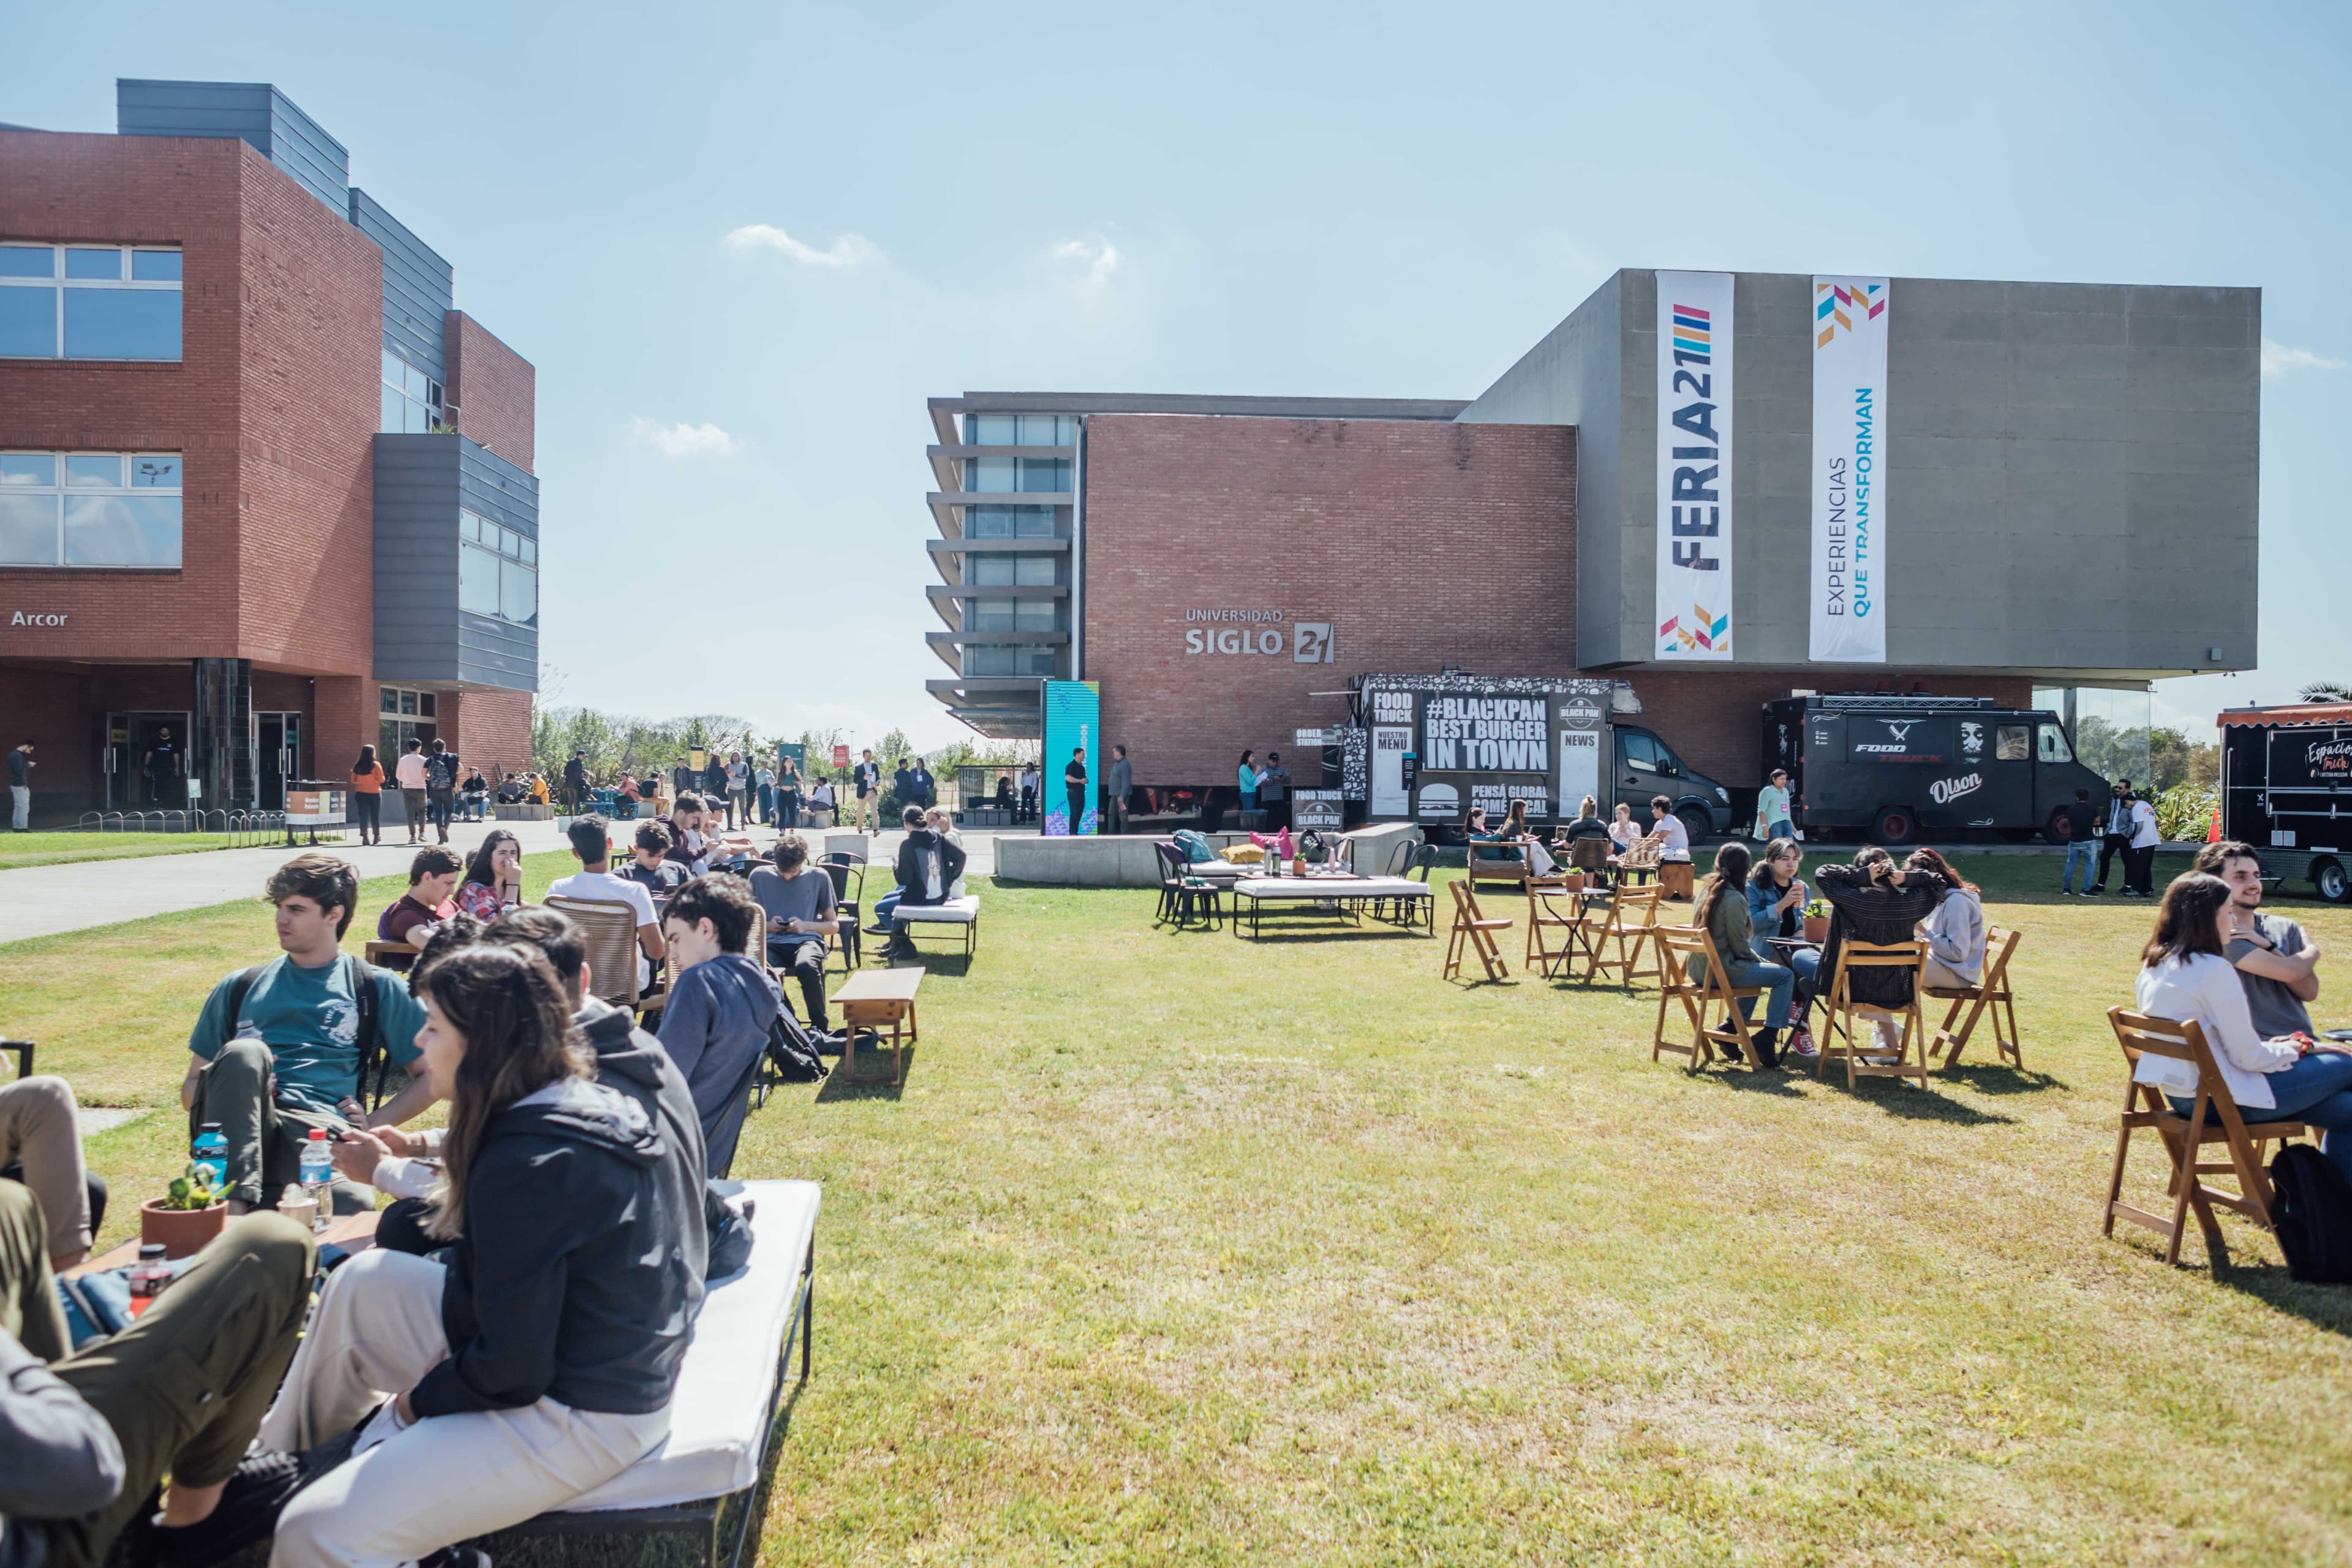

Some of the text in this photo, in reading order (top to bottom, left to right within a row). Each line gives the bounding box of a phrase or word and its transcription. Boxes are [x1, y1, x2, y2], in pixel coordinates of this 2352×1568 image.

[1672, 349, 1719, 571] FERIA21
[1853, 388, 1872, 617] QUE TRANSFORMAN
[1828, 458, 1846, 616] EXPERIENCIAS
[11, 611, 68, 626] Arcor
[1186, 609, 1283, 622] UNIVERSIDAD
[1185, 629, 1283, 655] SIGLO
[1374, 693, 1412, 709] FOOD
[1374, 709, 1412, 723] TRUCK
[1427, 698, 1546, 721] #BLACKPAN
[1561, 708, 1599, 718] BLACK PAN
[1297, 729, 1321, 737] ORDER
[1427, 719, 1547, 740] BEST BURGER
[1378, 739, 1407, 750] MENU
[1566, 735, 1594, 746] NEWS
[1427, 739, 1548, 770] IN TOWN
[1296, 791, 1343, 800] FOOD TRUCK
[1472, 783, 1548, 798] PENSÁ GLOBAL
[1930, 772, 1982, 804] Olson
[1298, 815, 1341, 825] BLACK PAN
